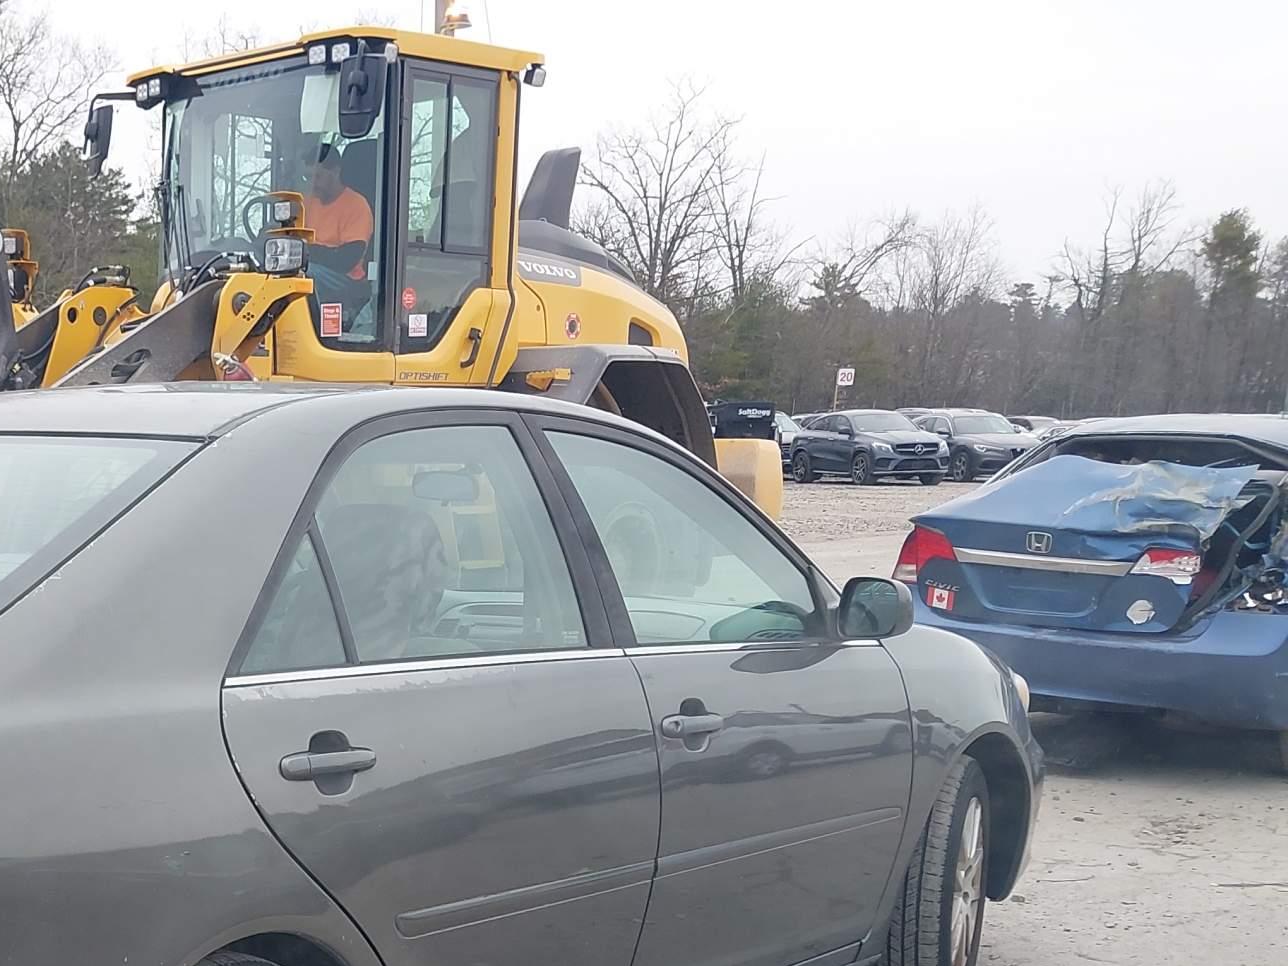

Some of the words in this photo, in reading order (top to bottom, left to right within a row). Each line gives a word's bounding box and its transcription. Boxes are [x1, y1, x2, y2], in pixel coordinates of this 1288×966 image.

[518, 260, 577, 279] VOLVO
[399, 371, 449, 381] OPTISHIFT
[840, 372, 852, 382] 20
[738, 408, 771, 417] SaltDogg
[925, 579, 960, 592] CIVIC
